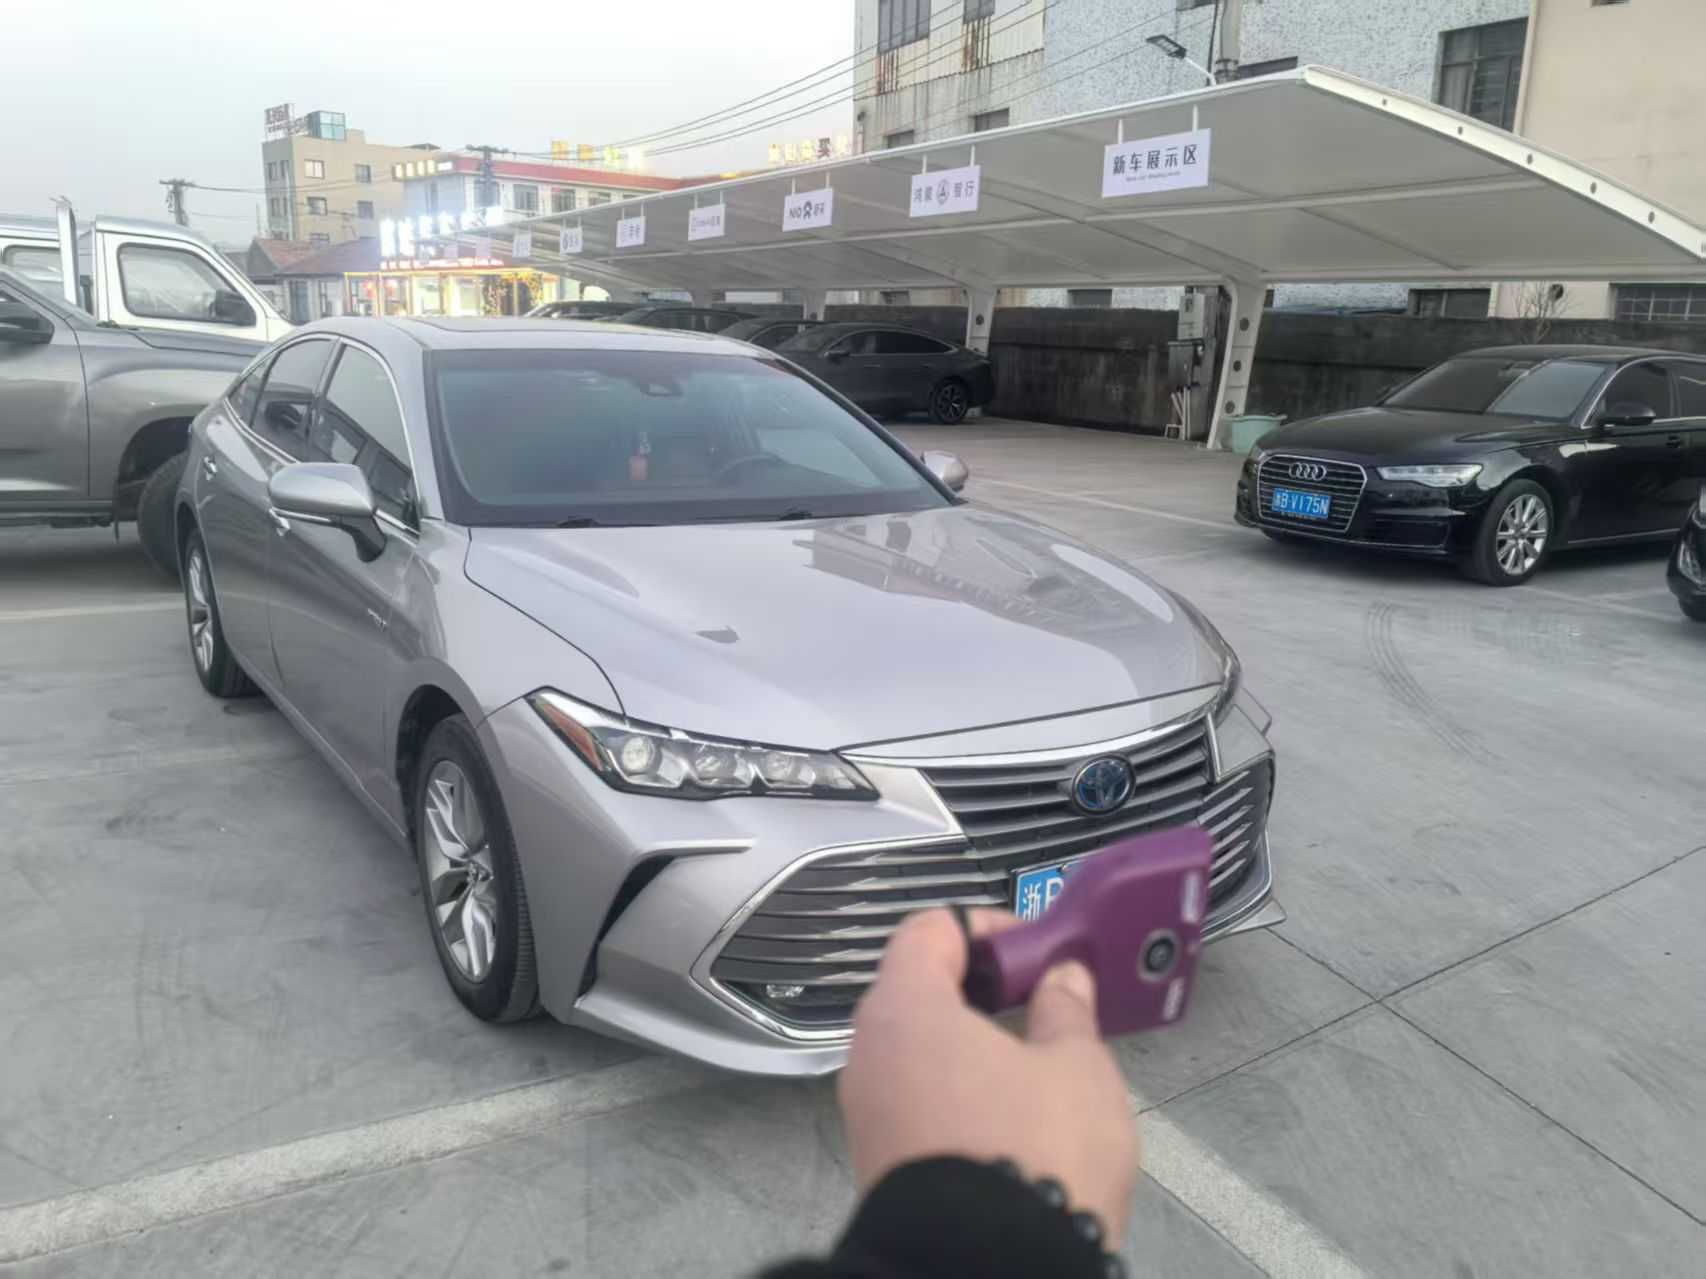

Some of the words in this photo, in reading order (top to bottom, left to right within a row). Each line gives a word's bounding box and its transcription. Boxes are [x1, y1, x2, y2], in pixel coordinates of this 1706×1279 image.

[1112, 143, 1198, 174] 新车展示区
